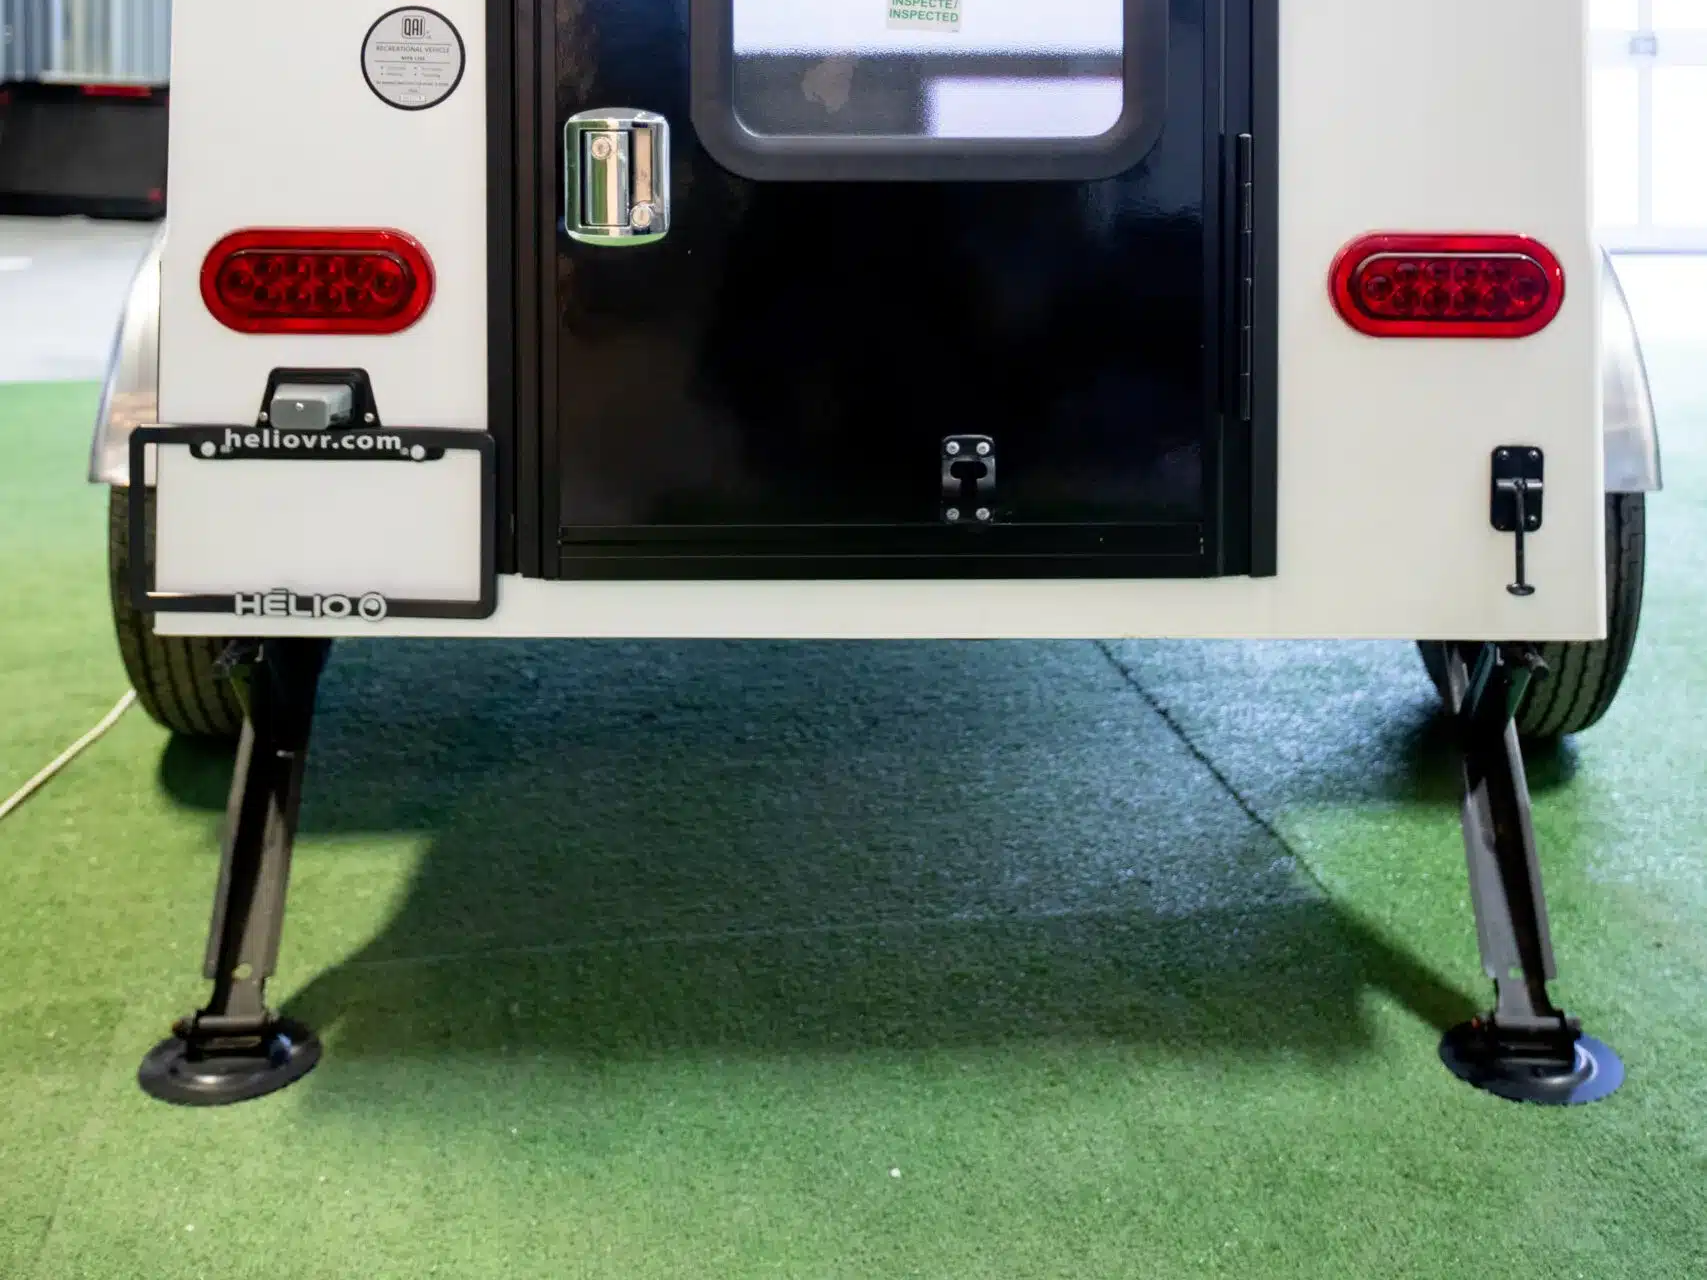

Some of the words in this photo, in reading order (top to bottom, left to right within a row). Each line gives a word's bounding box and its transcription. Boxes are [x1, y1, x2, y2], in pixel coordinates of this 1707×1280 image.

[889, 9, 958, 22] INSPECTED
[403, 18, 423, 36] QAI
[224, 428, 402, 451] heliovr.com
